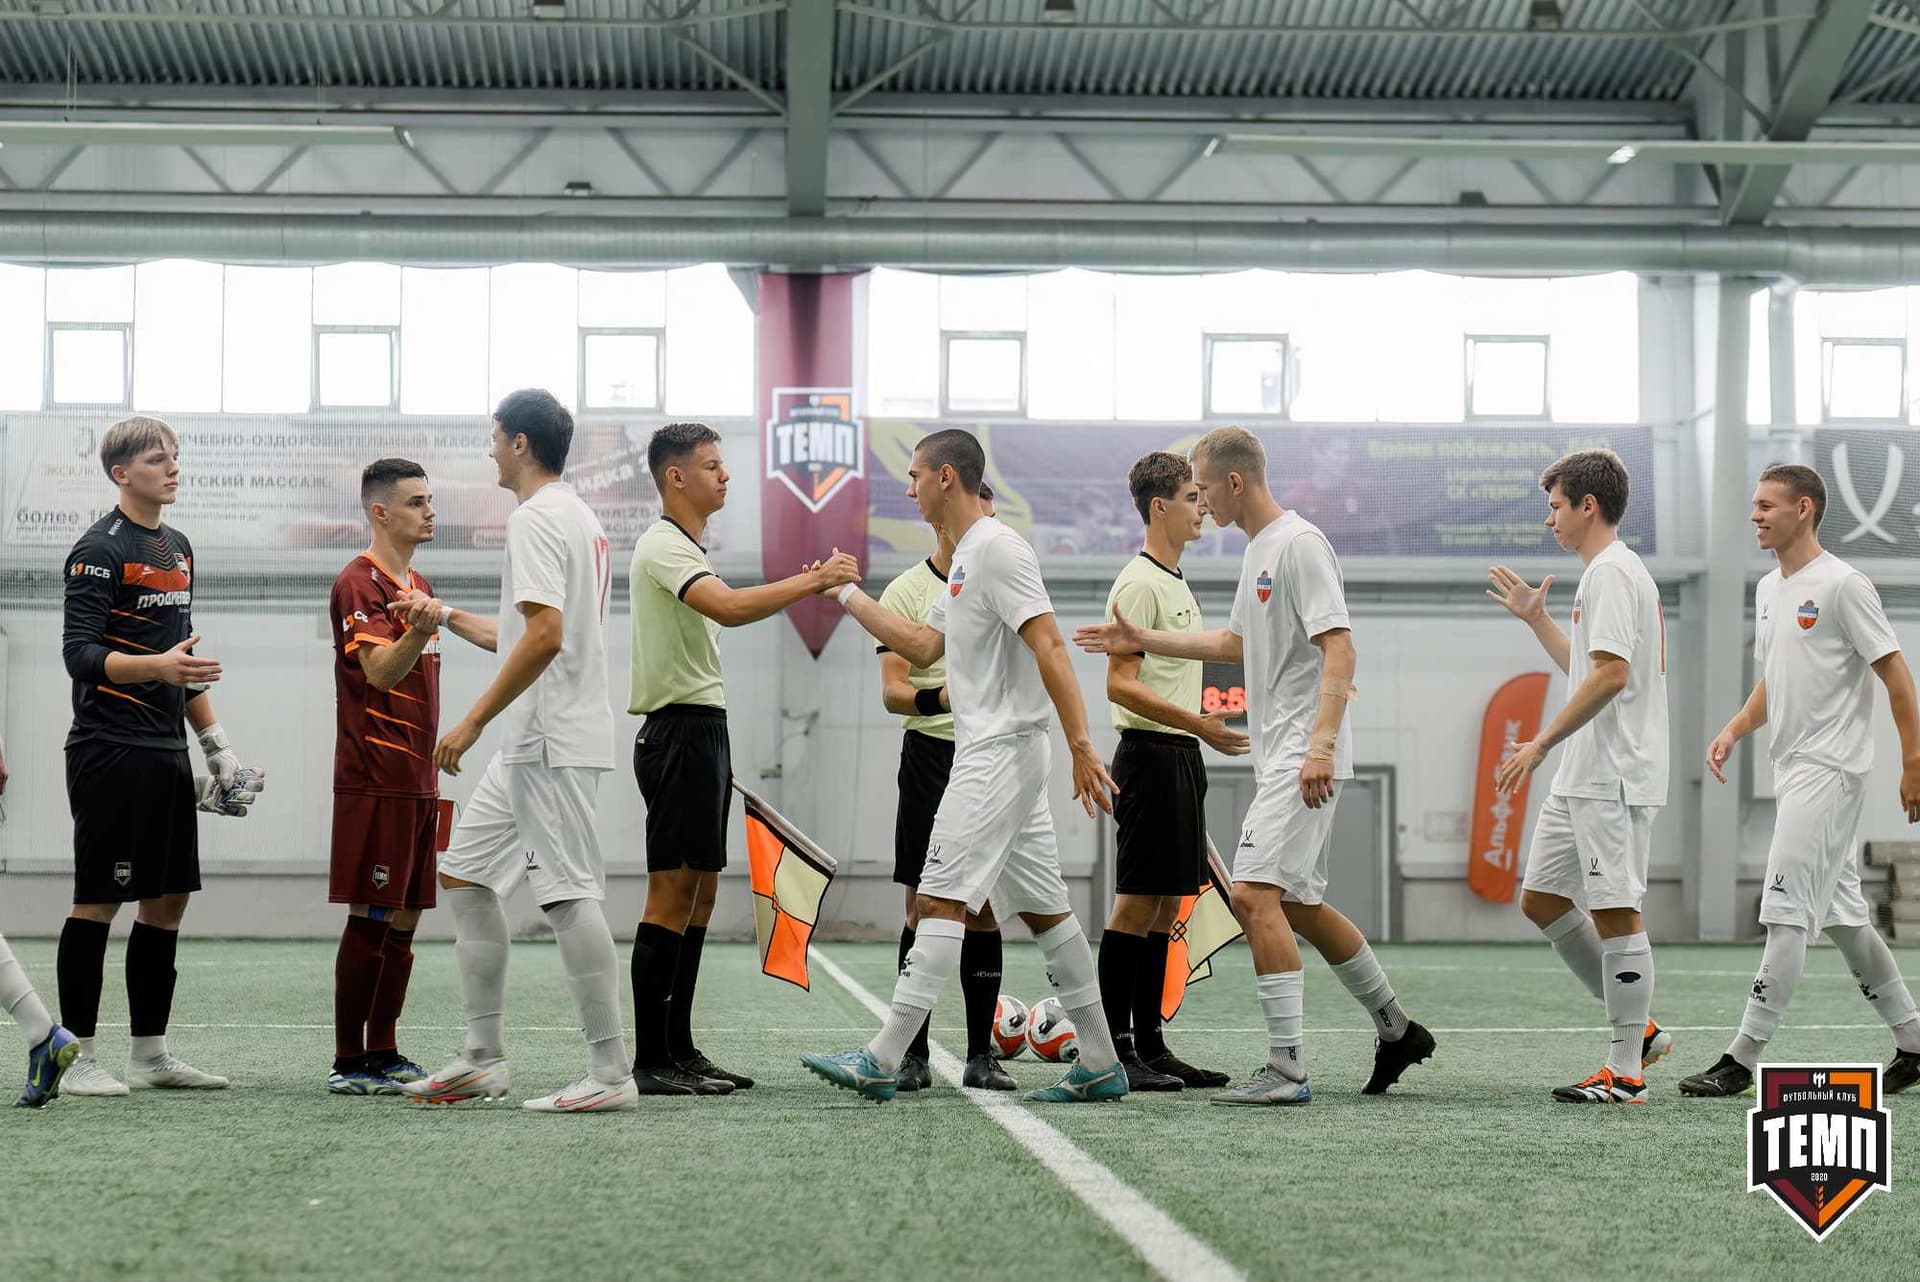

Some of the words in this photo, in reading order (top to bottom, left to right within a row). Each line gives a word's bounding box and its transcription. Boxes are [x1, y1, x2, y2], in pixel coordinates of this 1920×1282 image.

[177, 433, 428, 449] ЕЧЕБНО-ОЗДОРОВИТЕЛЬНЫЙ
[433, 435, 492, 449] МАССА
[775, 421, 855, 466] ТЕМП
[178, 473, 244, 488] ЕТСКИЙ
[16, 505, 80, 523] более
[84, 565, 111, 579] ПСБ
